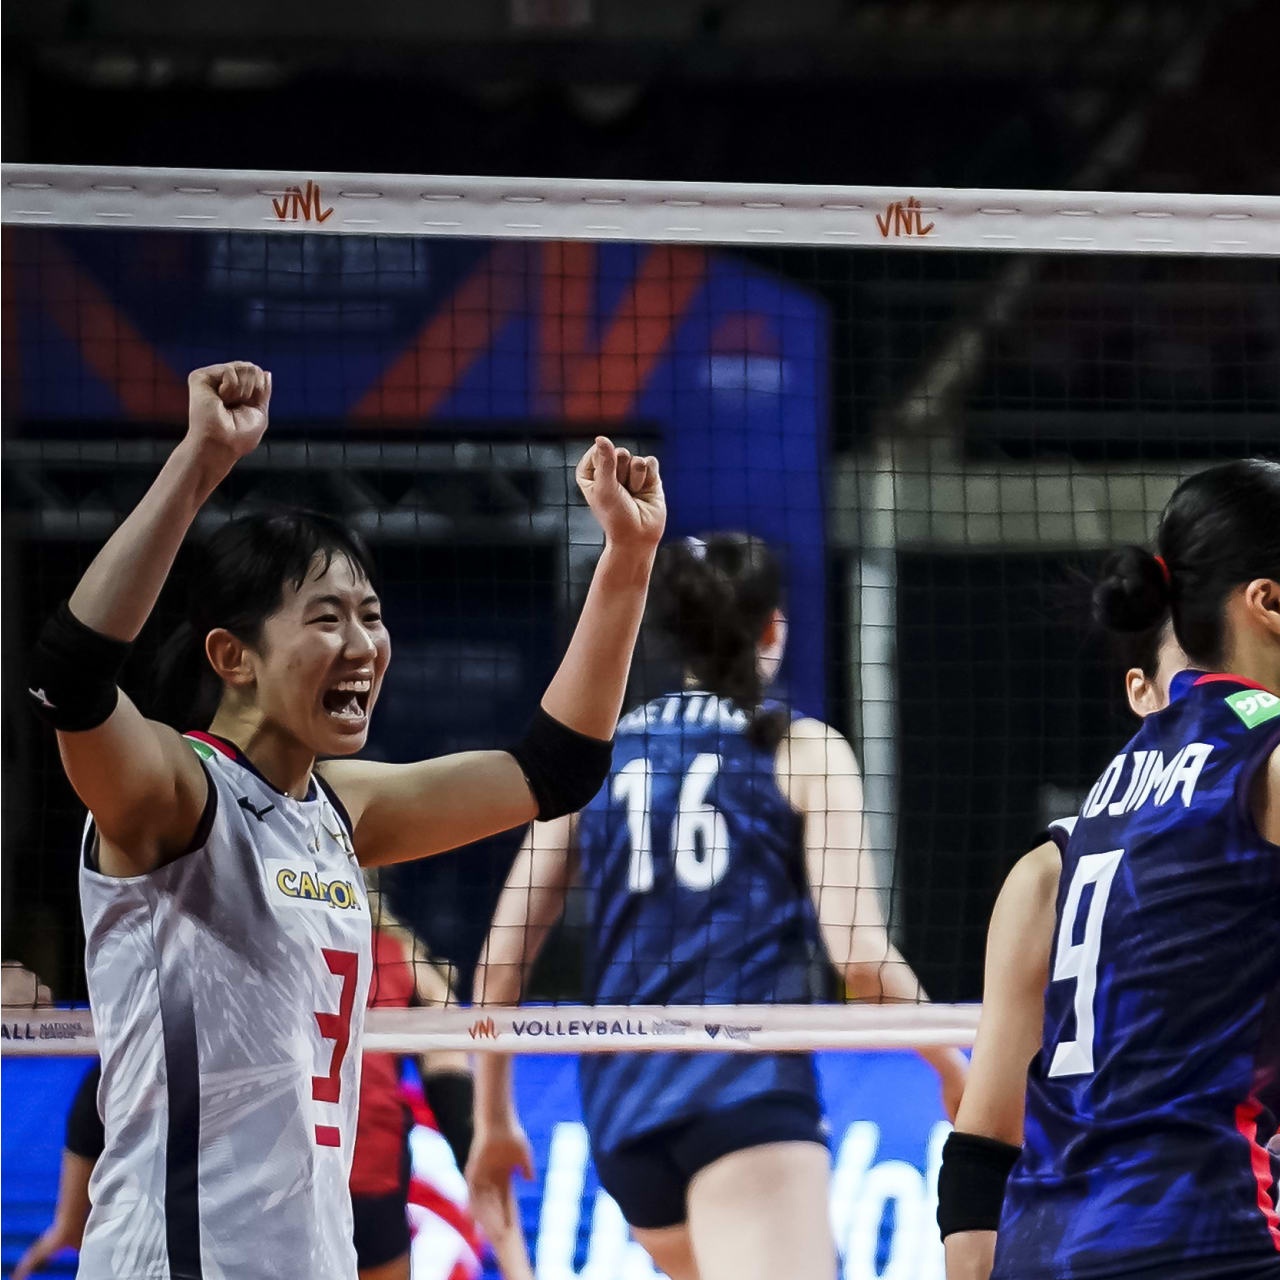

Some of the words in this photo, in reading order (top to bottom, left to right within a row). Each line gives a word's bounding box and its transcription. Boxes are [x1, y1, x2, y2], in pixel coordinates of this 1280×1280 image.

[271, 180, 334, 223] VNL
[876, 196, 935, 237] VNL
[612, 752, 731, 892] 16
[1048, 849, 1124, 1077] 9
[312, 948, 359, 1104] 3
[512, 1020, 647, 1037] VOLLEYBALL
